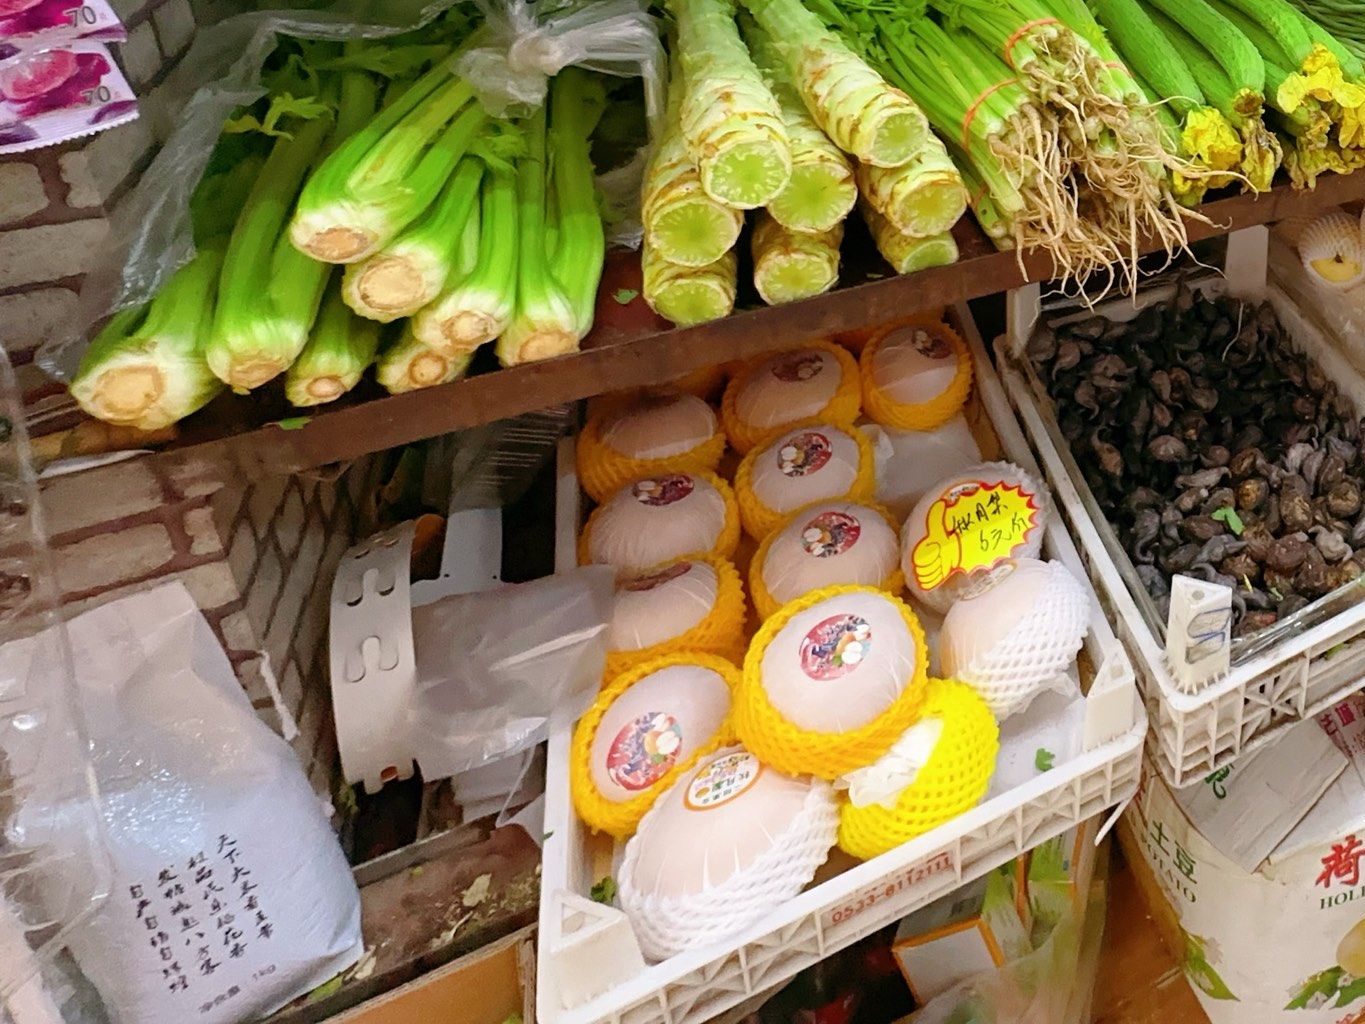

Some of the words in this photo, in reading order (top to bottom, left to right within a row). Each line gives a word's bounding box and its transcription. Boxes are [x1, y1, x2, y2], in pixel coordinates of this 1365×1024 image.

[65, 5, 97, 28] 70
[82, 85, 112, 106] 70
[1150, 820, 1198, 884] 土豆
